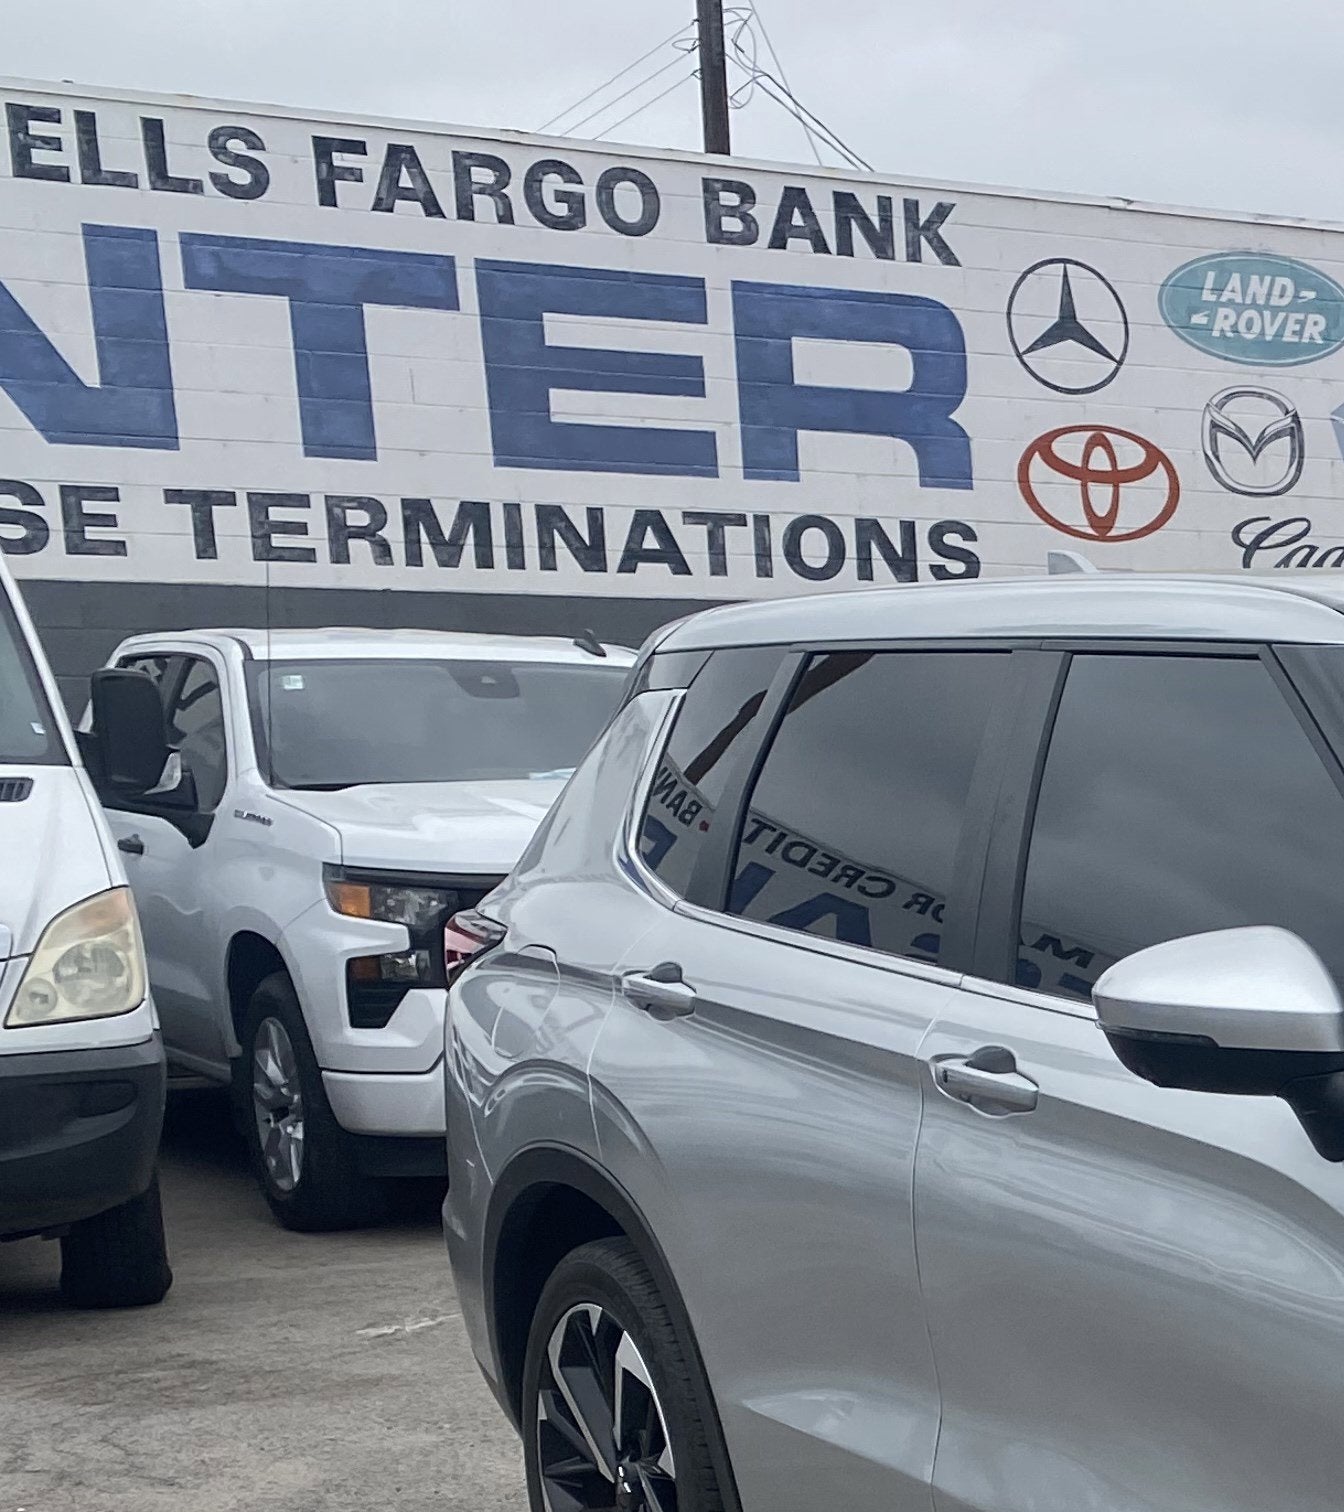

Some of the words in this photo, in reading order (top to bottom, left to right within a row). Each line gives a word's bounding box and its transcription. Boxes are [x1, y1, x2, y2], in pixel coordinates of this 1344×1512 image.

[5, 102, 271, 201] ELLS
[312, 134, 661, 237] FARGO
[702, 176, 962, 268] BANK
[1201, 270, 1296, 307] LAND
[1211, 307, 1327, 345] ROVER
[0, 478, 127, 557] SE
[163, 488, 981, 583] TERMINATIONS
